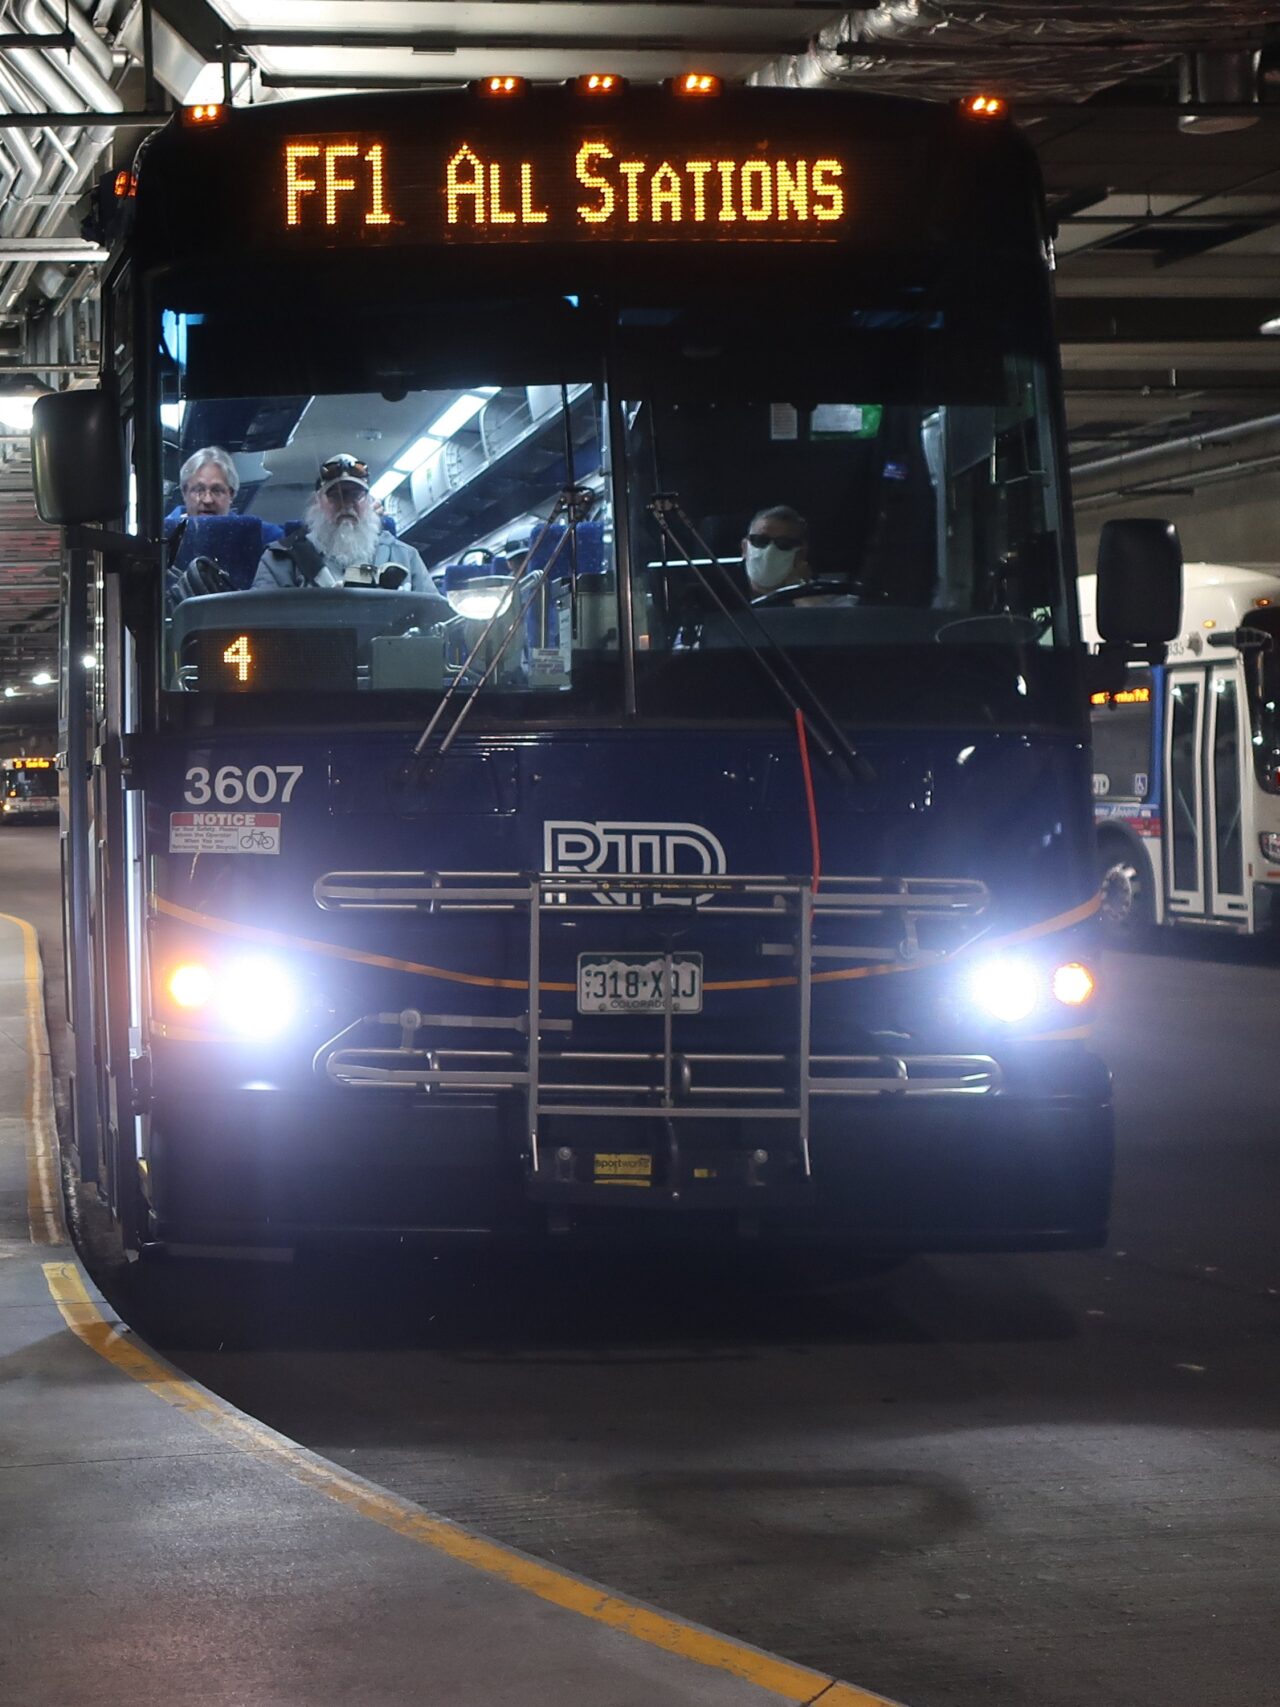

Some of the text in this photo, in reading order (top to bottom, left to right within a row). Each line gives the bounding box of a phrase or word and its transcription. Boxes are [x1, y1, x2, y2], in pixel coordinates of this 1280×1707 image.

[286, 145, 391, 225] FF1
[223, 636, 252, 681] 4
[184, 765, 304, 805] 3607
[193, 813, 256, 826] NOTICE
[543, 820, 727, 905] RTD
